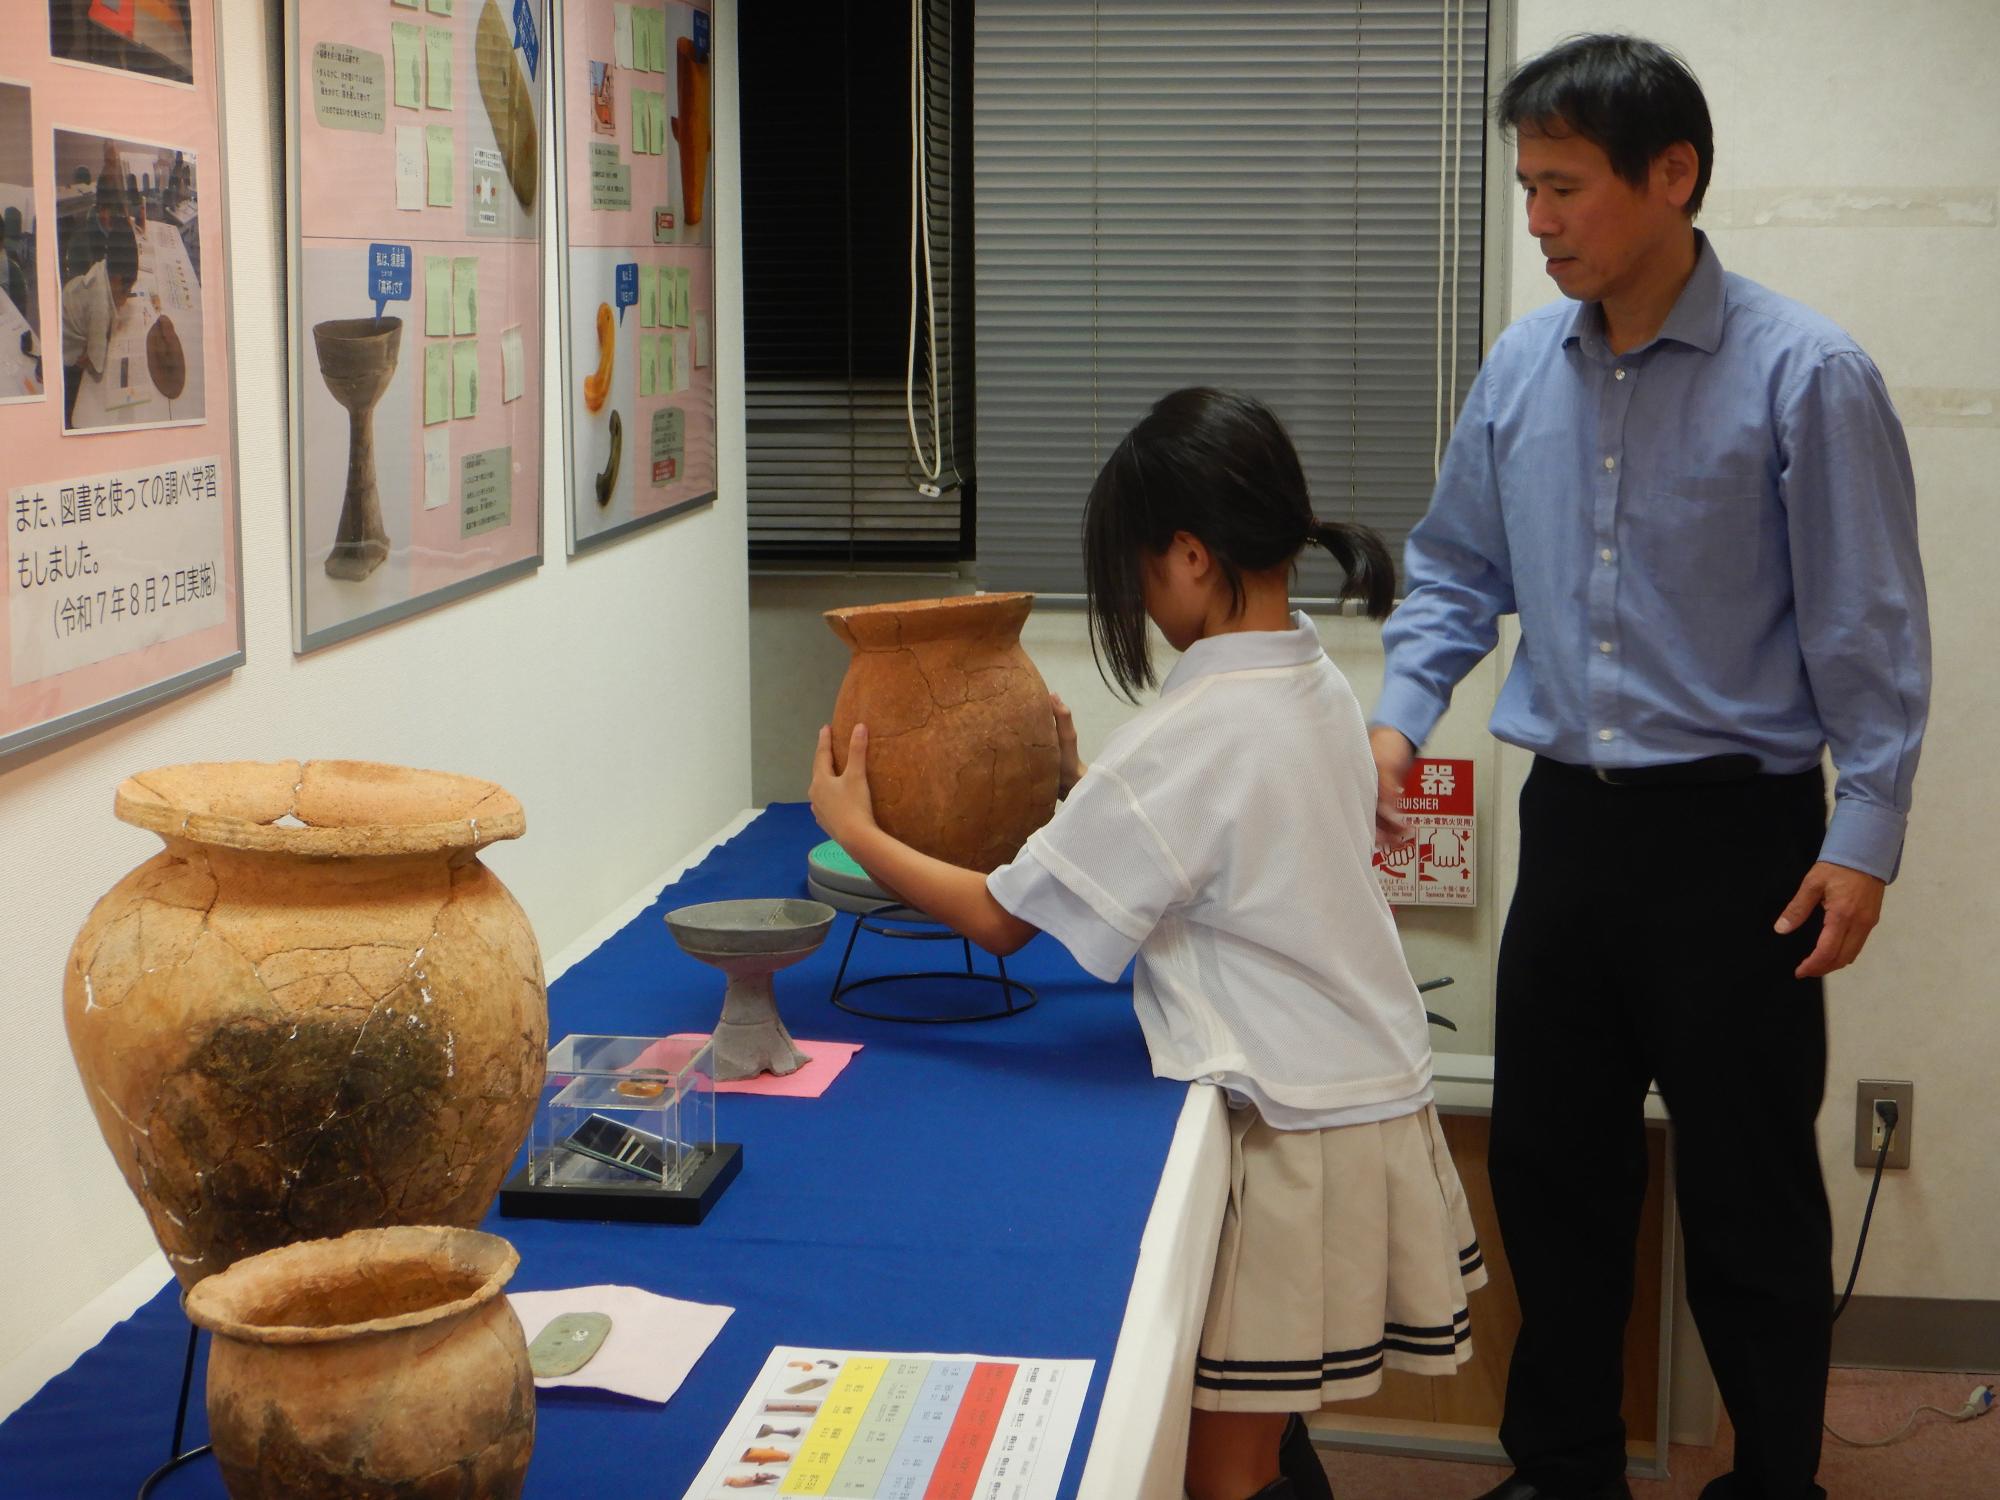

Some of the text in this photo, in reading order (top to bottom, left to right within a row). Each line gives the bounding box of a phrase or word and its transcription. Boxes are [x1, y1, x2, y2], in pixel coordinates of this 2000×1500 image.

[15, 464, 217, 532] また、図書を使っての調べ学習
[17, 540, 99, 589] もしました。
[1420, 764, 1456, 795] 器
